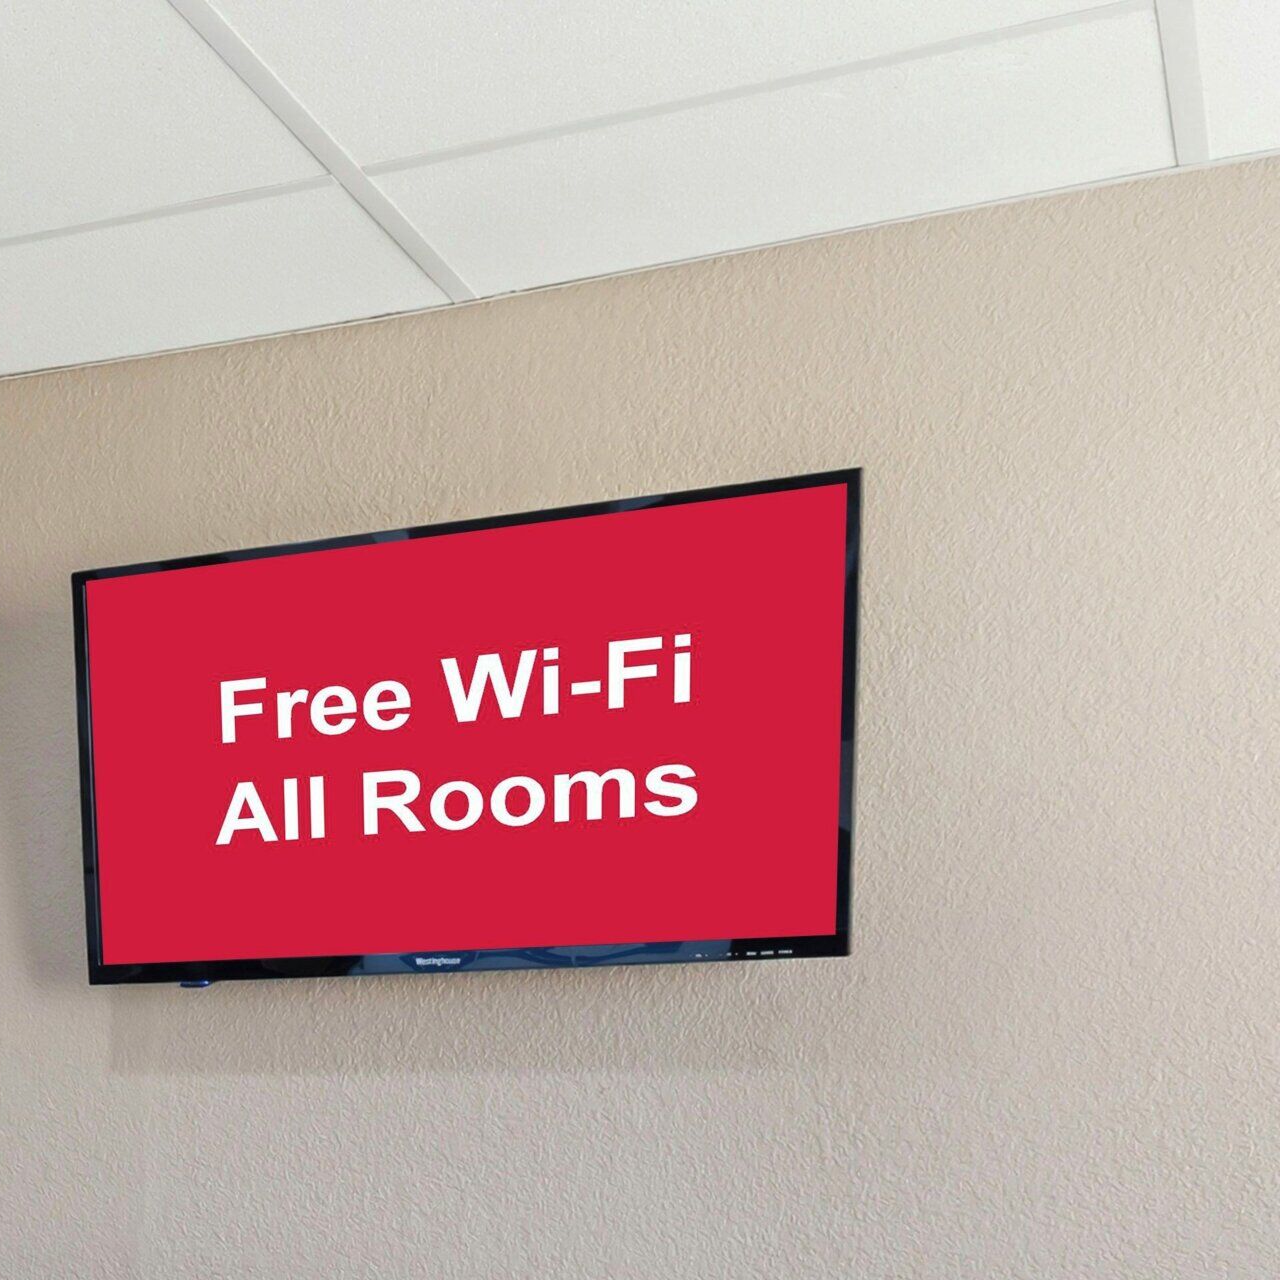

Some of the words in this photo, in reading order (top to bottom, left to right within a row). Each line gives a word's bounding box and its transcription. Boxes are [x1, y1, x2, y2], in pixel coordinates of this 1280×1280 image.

[219, 676, 412, 744] Free
[440, 633, 692, 724] Wi-Fi
[215, 774, 327, 846] All
[362, 762, 699, 836] Rooms
